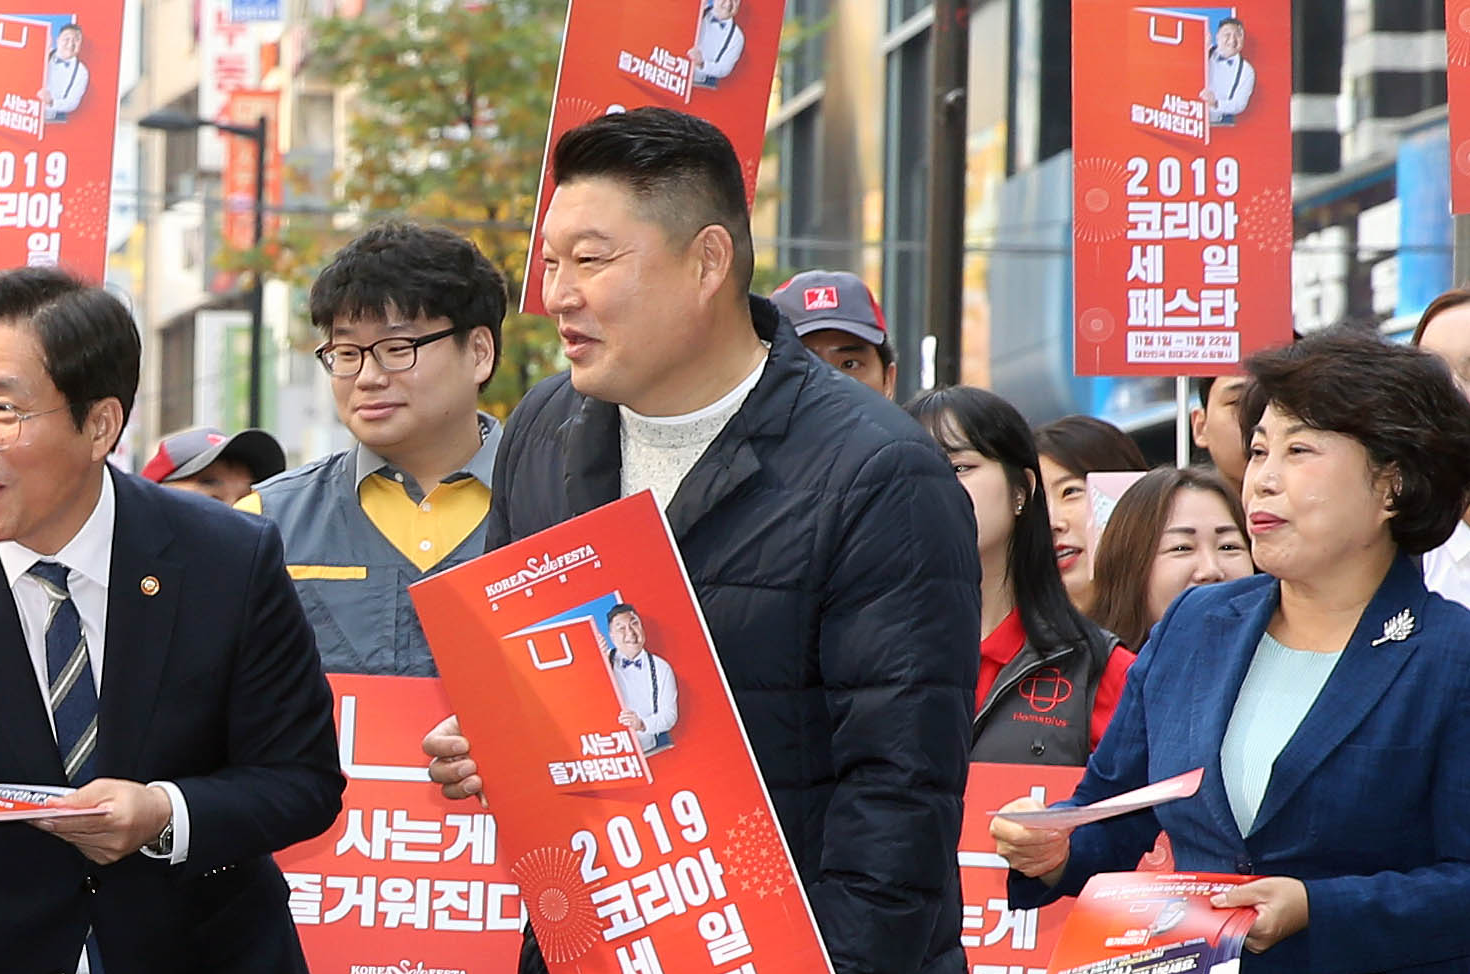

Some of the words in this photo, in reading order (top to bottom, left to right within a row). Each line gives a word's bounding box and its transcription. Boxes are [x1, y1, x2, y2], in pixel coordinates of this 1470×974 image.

[650, 46, 690, 78] 사는게
[2, 93, 40, 116] 사는게
[1162, 93, 1204, 119] 사는게
[1126, 156, 1239, 197] 2019
[1126, 201, 1239, 240] 코리아
[1127, 288, 1240, 327] 페스타
[485, 573, 527, 598] KOREA
[557, 544, 595, 568] FESTA
[580, 730, 635, 756] 사는게
[548, 754, 644, 785] 즐거워진다!
[335, 809, 497, 866] 사는게
[569, 790, 709, 885] 2019
[590, 847, 728, 942] 코리아
